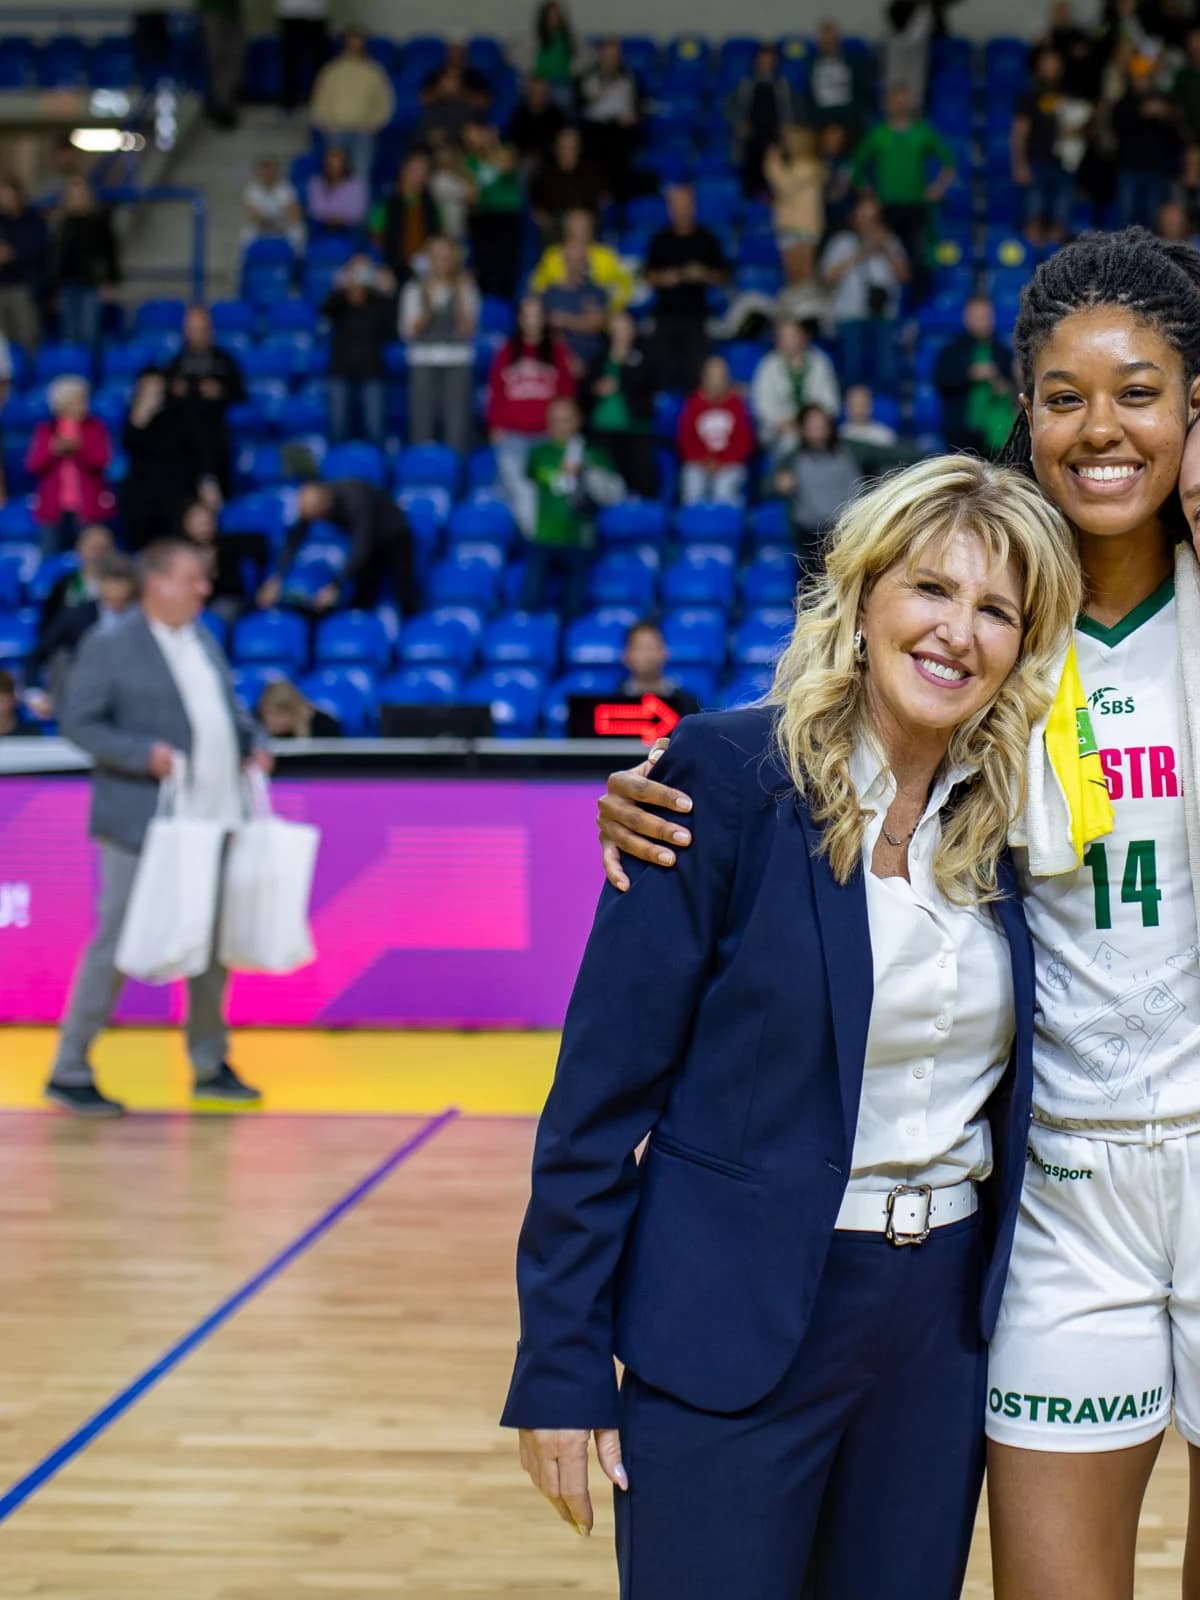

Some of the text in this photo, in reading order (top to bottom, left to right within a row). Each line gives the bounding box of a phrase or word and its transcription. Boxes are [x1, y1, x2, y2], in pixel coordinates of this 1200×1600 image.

[1100, 696, 1135, 715] SBŠ
[1099, 745, 1184, 800] STR
[1083, 840, 1162, 930] 14
[988, 1386, 1163, 1425] OSTRAVA!!!
